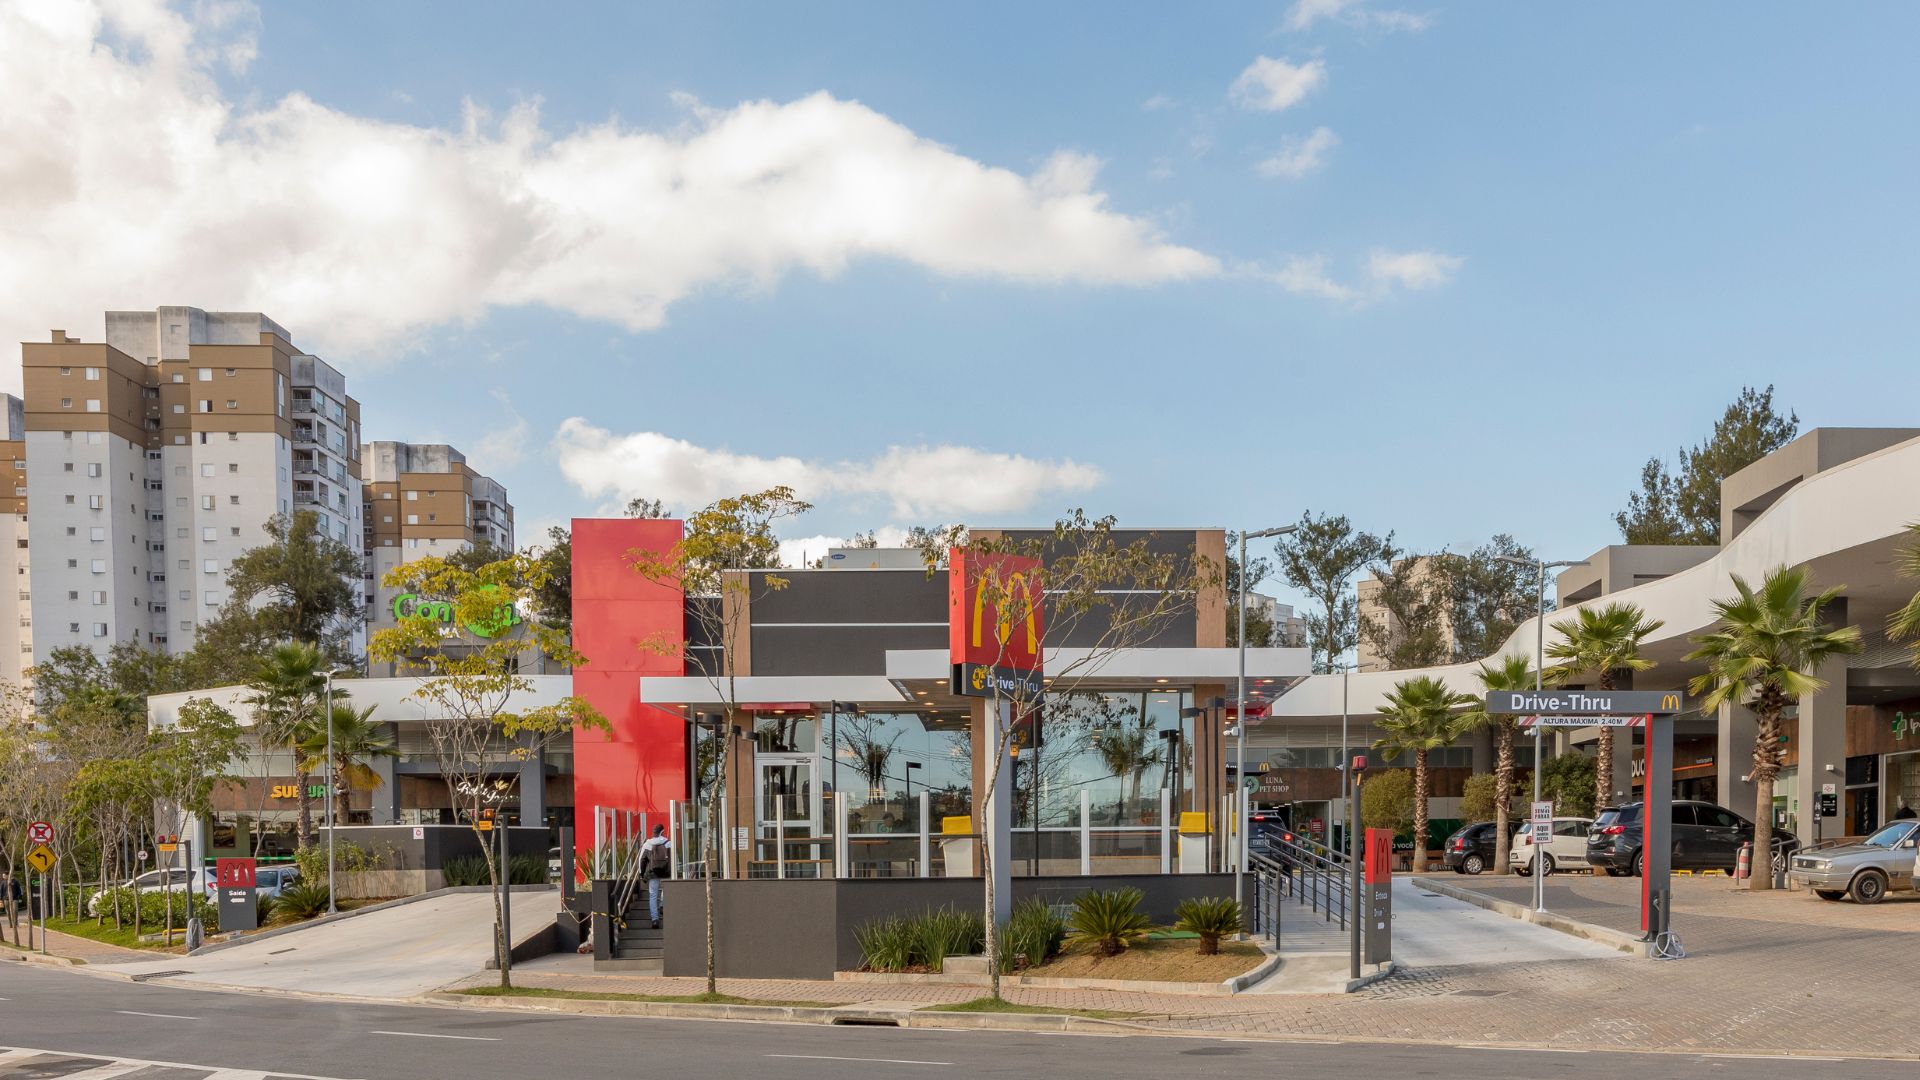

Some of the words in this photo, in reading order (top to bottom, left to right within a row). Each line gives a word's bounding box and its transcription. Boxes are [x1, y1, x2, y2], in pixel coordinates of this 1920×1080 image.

[1511, 694, 1611, 710] Drive-Thru
[1570, 717, 1598, 725] MÁXIMA
[1265, 776, 1283, 784] LUNA
